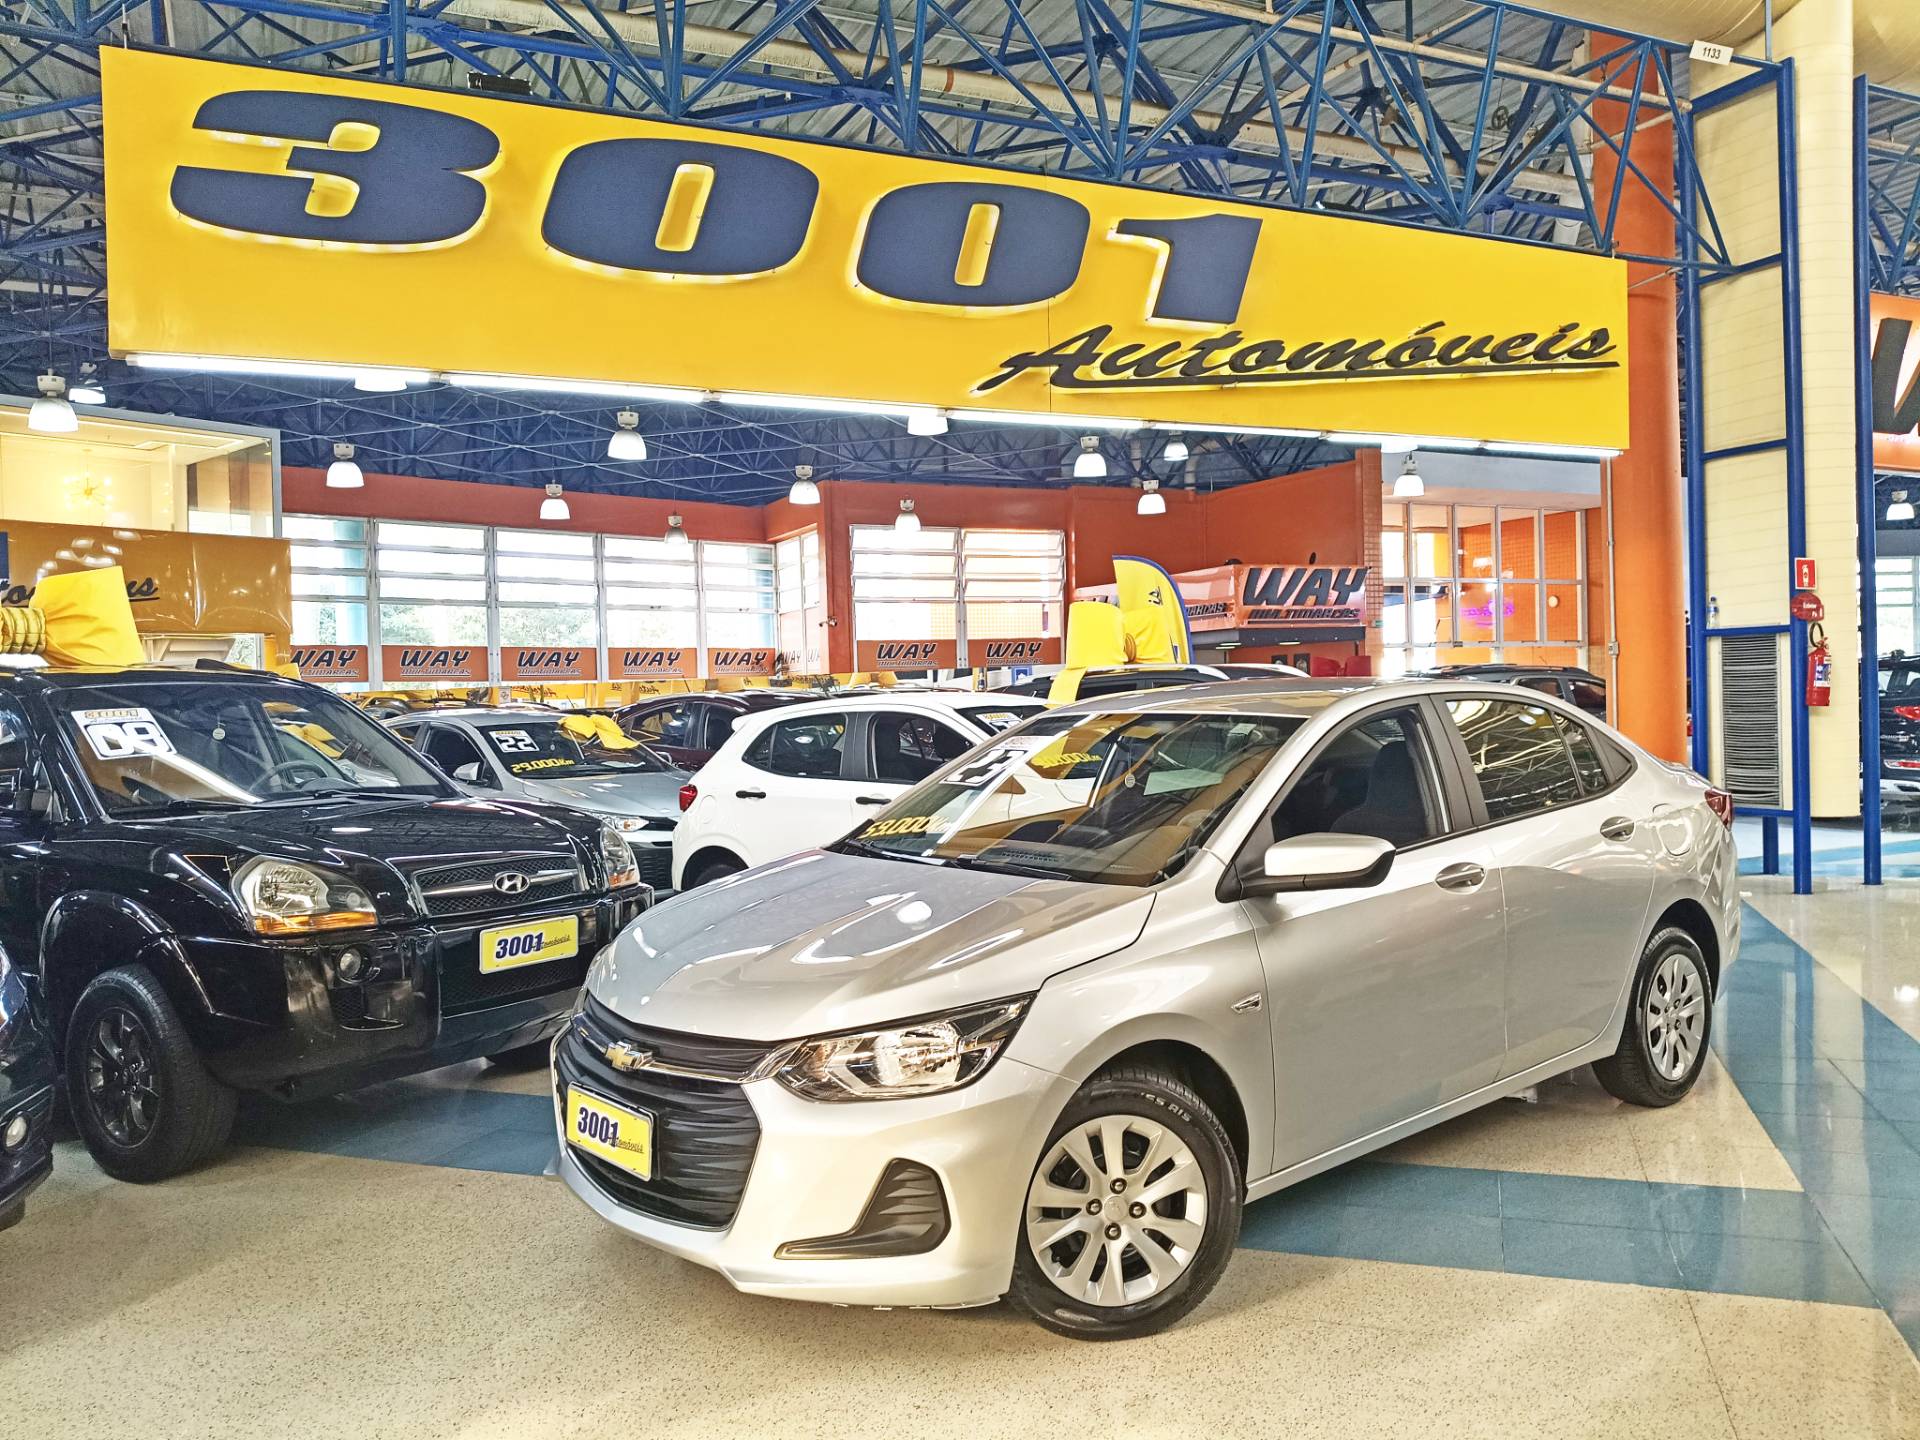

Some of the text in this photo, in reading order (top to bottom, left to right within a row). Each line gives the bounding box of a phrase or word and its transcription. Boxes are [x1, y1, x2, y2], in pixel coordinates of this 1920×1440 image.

[1703, 46, 1722, 60] 1133
[170, 90, 1264, 324] 3001
[976, 320, 1620, 390] Automóveis
[1242, 567, 1368, 606] WAY
[877, 643, 937, 659] WAY
[986, 641, 1043, 658] WAY
[401, 650, 470, 667] WAY
[518, 651, 580, 667] WAY
[624, 651, 681, 666] WAY
[714, 651, 768, 666] WAY
[496, 736, 538, 751] 22
[495, 932, 544, 959] 3001
[577, 1106, 619, 1148] 3001
